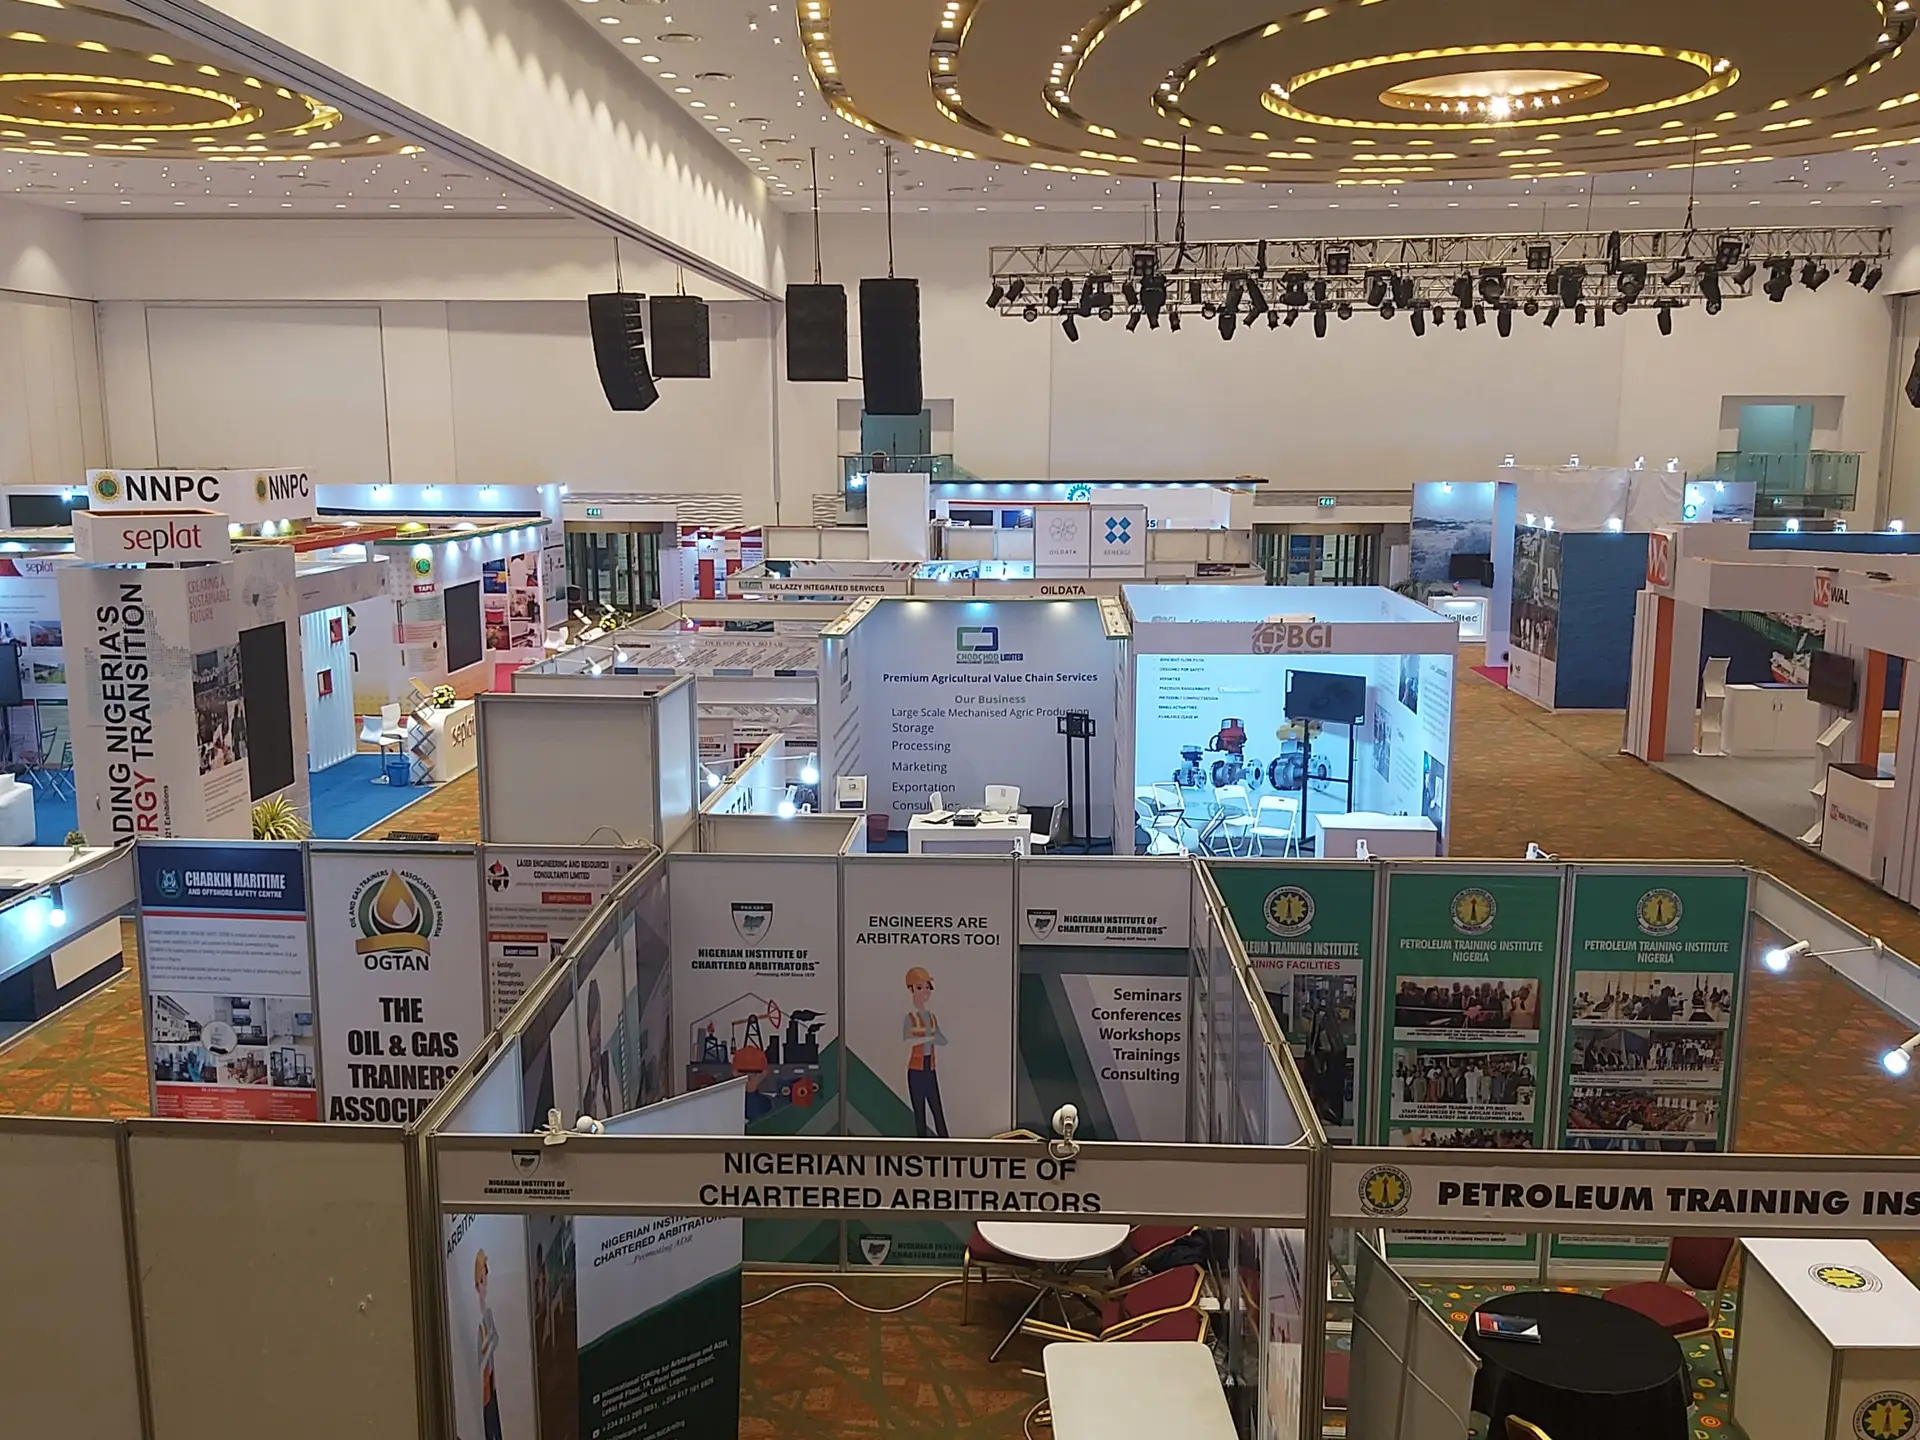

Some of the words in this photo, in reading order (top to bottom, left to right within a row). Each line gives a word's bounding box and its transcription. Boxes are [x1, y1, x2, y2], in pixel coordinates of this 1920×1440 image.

[125, 476, 220, 502] NNPC
[269, 473, 309, 500] NNPC
[122, 521, 202, 556] seplat
[25, 560, 54, 575] seplat
[188, 576, 219, 593] CREATING
[769, 583, 802, 591] MCLAZZY
[803, 584, 849, 592] INTEGRATED
[1040, 585, 1086, 596] OILDATA
[1830, 587, 1850, 605] WAL
[190, 607, 215, 625] FUTURE
[1287, 625, 1333, 648] BGI
[956, 652, 999, 661] CHODCHOD
[96, 604, 129, 754] NIGERIA'S
[119, 583, 154, 763] TRANSITION
[883, 673, 929, 683] Premium
[931, 673, 992, 684] Agricultural
[993, 673, 1023, 683] Value
[1024, 673, 1054, 682] Chain
[1056, 673, 1098, 682] Services
[954, 694, 976, 704] Our
[978, 694, 1026, 704] Business
[891, 708, 919, 720] Large
[920, 708, 946, 718] Scale
[948, 708, 1008, 718] Mechanised
[1009, 708, 1034, 720] Agric
[892, 722, 935, 736] Storage
[892, 740, 952, 754] Processing
[892, 761, 948, 775] Marketing
[892, 782, 956, 796] Exportation
[133, 770, 160, 834] RGY
[163, 784, 172, 826] Exhibitions
[532, 860, 568, 868] ENGINEERING
[568, 860, 580, 868] AND
[184, 871, 232, 888] CHARKIN
[233, 872, 286, 890] MARITIME
[570, 872, 590, 880] LIMITED
[188, 888, 201, 896] AND
[202, 888, 233, 897] OFFSHORE
[234, 889, 258, 898] SAFETY
[258, 890, 282, 898] CENTRE
[352, 887, 362, 900] GAS
[359, 870, 389, 888] TRAINERS
[400, 870, 437, 900] ASSOCIATION
[434, 911, 444, 937] NIGERIA
[868, 916, 954, 929] ENGINEERS
[956, 916, 988, 930] ARE
[1064, 915, 1102, 924] NIGERIAN
[1104, 916, 1146, 924] INSTITUTE
[1146, 916, 1158, 925] OF
[1058, 925, 1104, 934] CHARTERED
[856, 932, 960, 946] ARBITRATORS
[965, 933, 1000, 946] TOO!
[1400, 939, 1452, 950] PETROLEUM
[1454, 940, 1497, 951] TRAINING
[1500, 941, 1544, 952] INSTITUTE
[1584, 940, 1637, 951] PETROLEUM
[1638, 941, 1683, 952] TRAINING
[1684, 942, 1730, 953] INSTITUTE
[698, 948, 744, 958] NIGERIAN
[745, 949, 794, 959] INSTITUTE
[796, 950, 808, 959] OF
[1244, 941, 1269, 954] LEUM
[1270, 942, 1312, 955] TRAINING
[1314, 942, 1360, 956] INSTITUTE
[364, 954, 429, 971] OGTAN
[1452, 952, 1490, 962] NIGERIA
[1637, 953, 1674, 964] NIGERIA
[691, 960, 747, 970] CHARTERED
[1286, 960, 1341, 970] FACILITIES
[1113, 988, 1182, 1002] Seminars
[378, 997, 424, 1024] THE
[1091, 1008, 1182, 1022] Conferences
[1099, 1028, 1181, 1044] Workshops
[348, 1030, 384, 1056] OIL
[389, 1032, 408, 1057] &
[411, 1032, 459, 1058] GAS
[1112, 1048, 1180, 1064] Trainings
[348, 1063, 460, 1091] TRAINERS
[1100, 1067, 1180, 1084] Consulting
[330, 1096, 434, 1123] ASSOCIA
[723, 1152, 866, 1176] NIGERIAN
[876, 1155, 1027, 1180] INSTITUTE
[1036, 1158, 1076, 1182] OF
[488, 1179, 520, 1187] NIGERIAN
[698, 1184, 882, 1209] CHARTERED
[890, 1188, 1102, 1214] ARBITRATORS
[1438, 1181, 1654, 1212] PETROLEUM
[1666, 1187, 1850, 1216] TRAINING
[600, 1223, 651, 1252] NIGERIAN
[674, 1234, 694, 1251] ADR
[593, 1234, 656, 1268] CHARTERED
[602, 1376, 640, 1400] International
[640, 1368, 660, 1381] Centre
[702, 1344, 713, 1355] and
